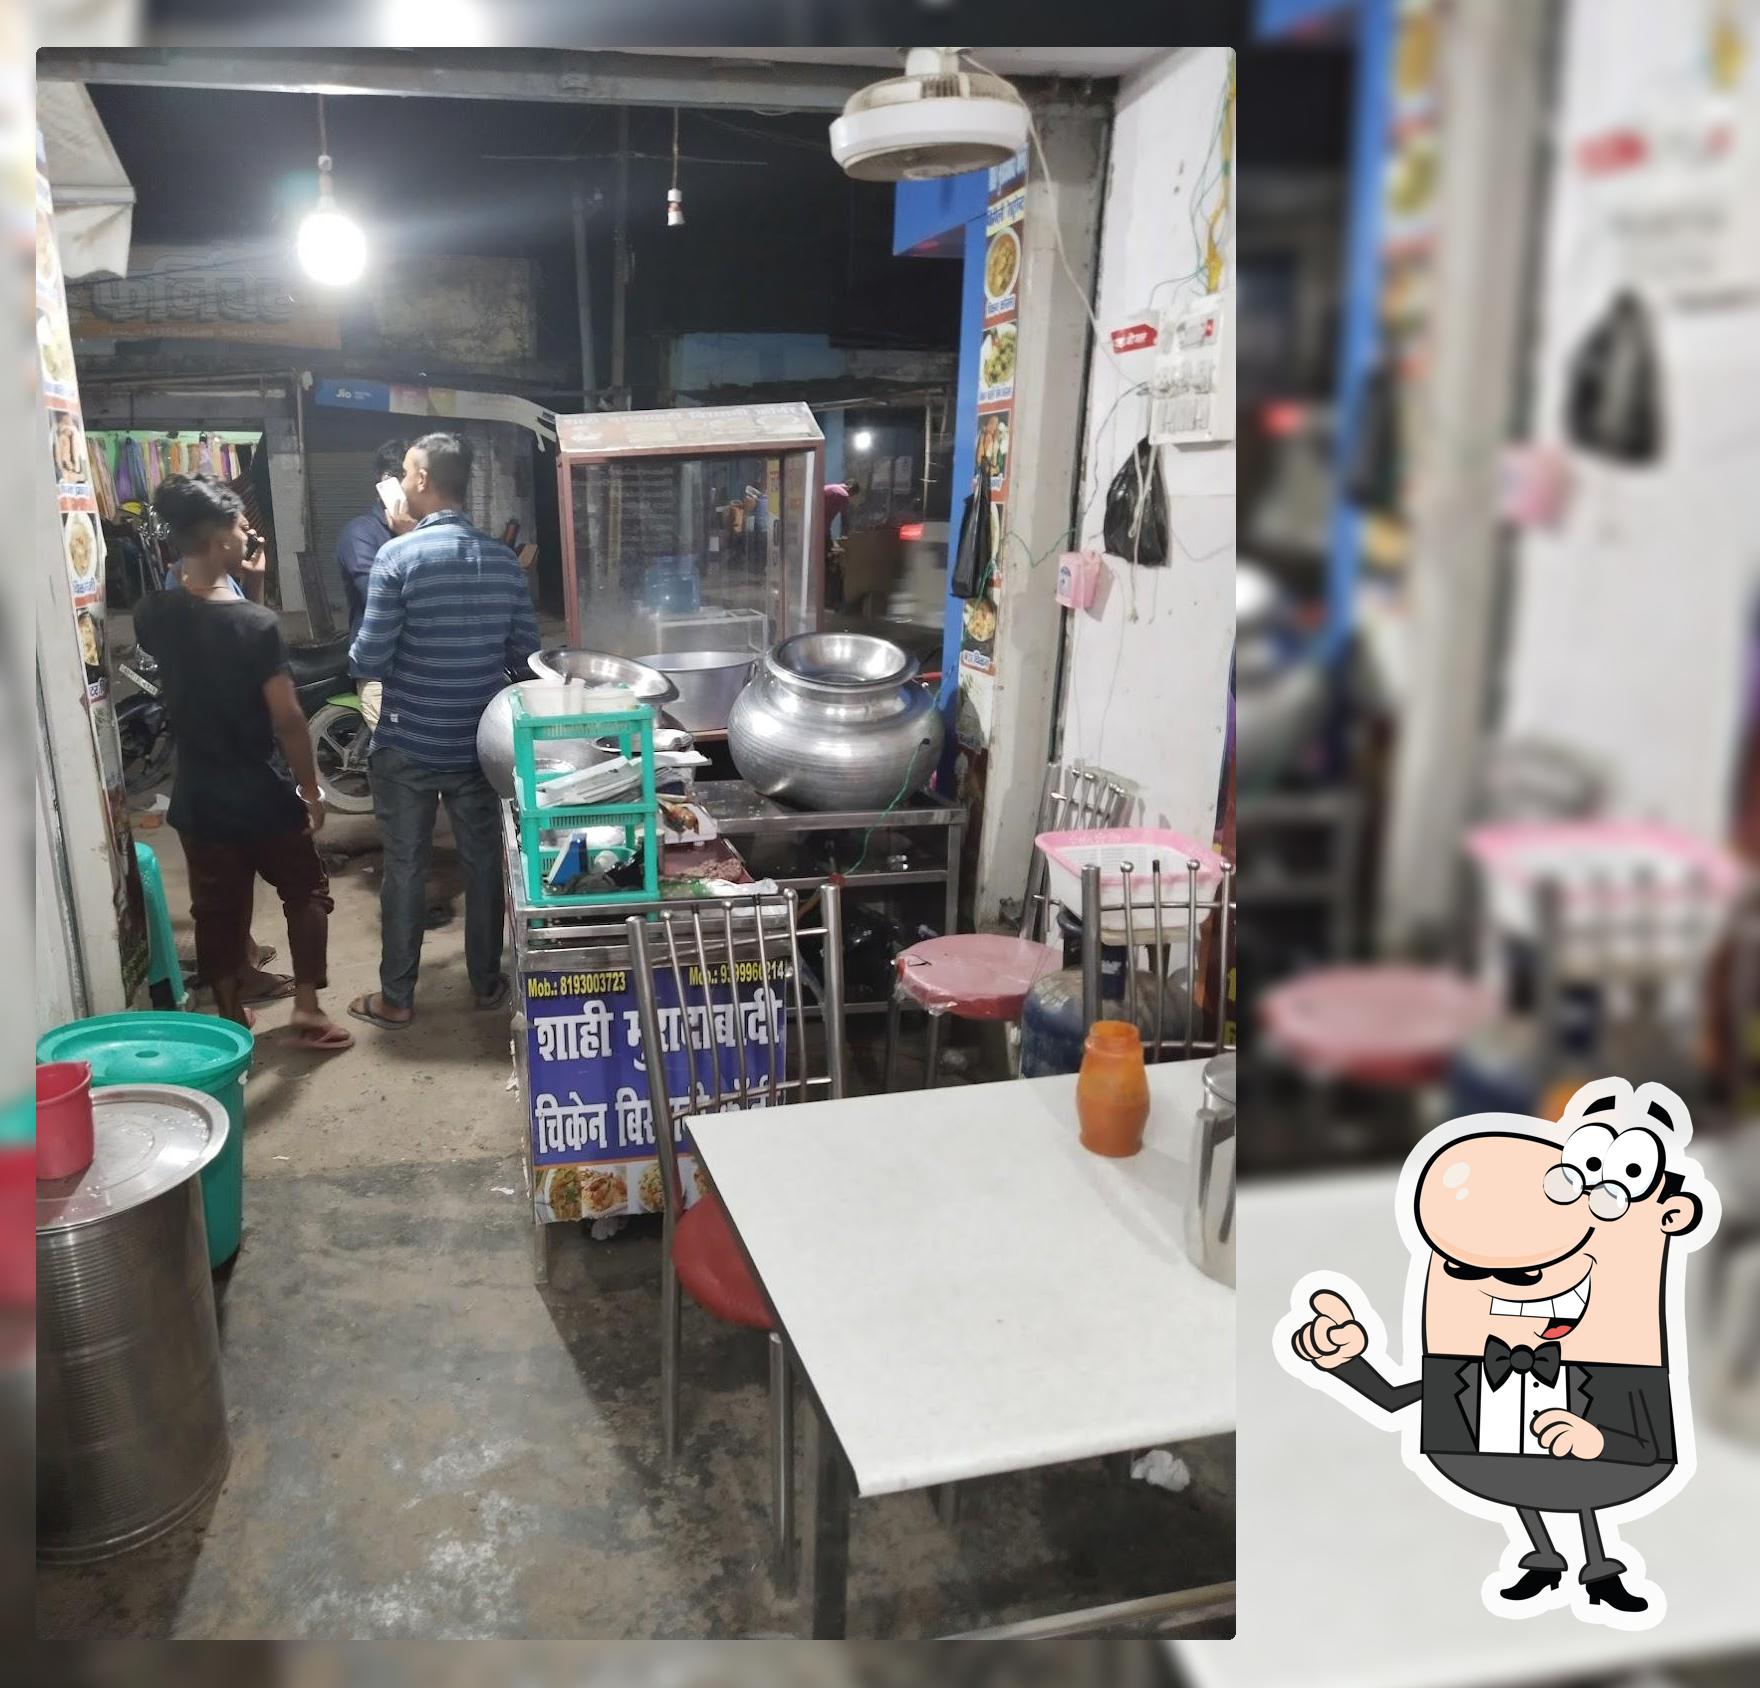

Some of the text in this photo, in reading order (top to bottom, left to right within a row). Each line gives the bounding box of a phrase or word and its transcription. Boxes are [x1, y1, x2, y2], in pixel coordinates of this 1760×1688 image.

[335, 387, 352, 399] Jio
[560, 972, 626, 996] 8193003723
[533, 1000, 615, 1061] शाही
